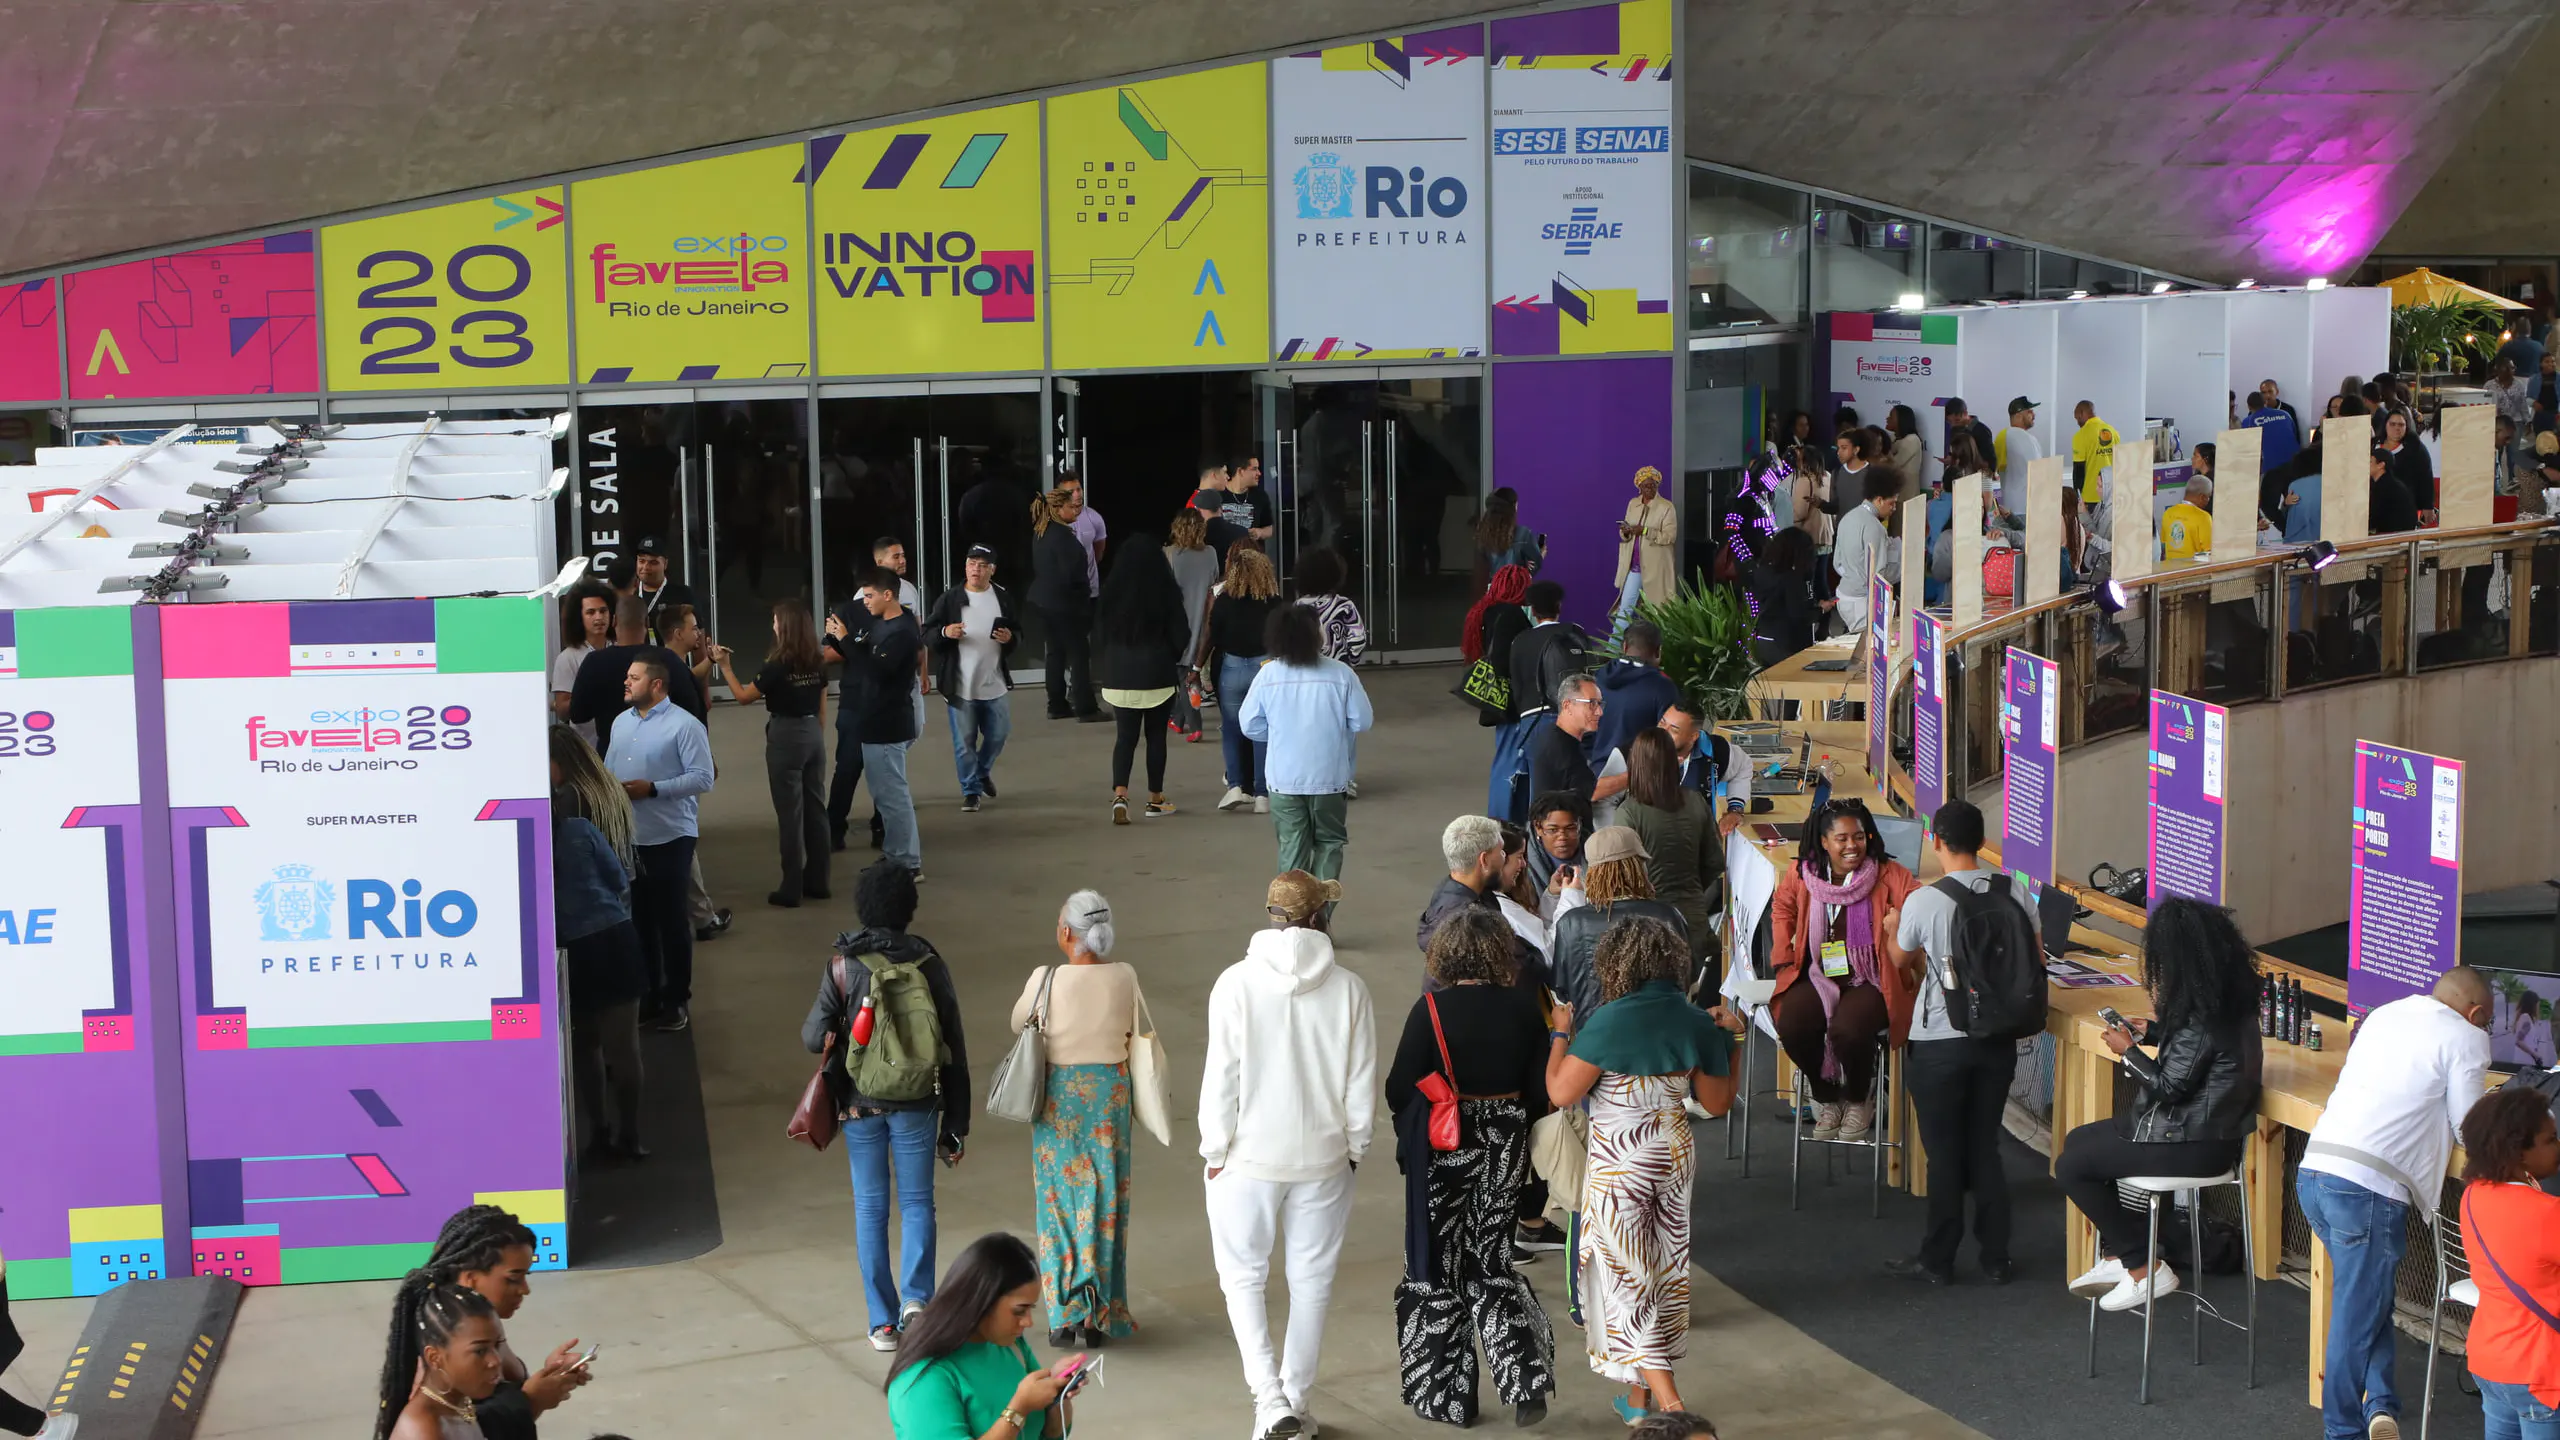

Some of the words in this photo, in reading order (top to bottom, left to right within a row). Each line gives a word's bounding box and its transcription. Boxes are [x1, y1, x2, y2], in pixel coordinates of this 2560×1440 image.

[1493, 108, 1524, 116] DIAMANTE
[1294, 136, 1320, 145] SUPER
[1321, 135, 1353, 145] MASTER
[1500, 130, 1560, 152] SESI
[1581, 129, 1663, 151] SENAI
[1524, 158, 1545, 166] PELO
[1547, 157, 1580, 166] FUTURO
[1581, 157, 1594, 165] DO
[1596, 157, 1639, 165] TRABALHO
[1366, 166, 1468, 219] Rio
[1297, 230, 1467, 247] PREFEITURA
[1541, 222, 1623, 240] SEBRAE
[673, 235, 788, 258] expo
[824, 231, 976, 264] INNO
[357, 244, 532, 309] 20
[825, 264, 1034, 298] VATION
[609, 301, 651, 317] Rio
[656, 300, 681, 316] de
[686, 300, 789, 316] Janeiro
[359, 309, 534, 375] 23
[1909, 356, 1932, 366] 20
[1909, 366, 1932, 376] 23
[186, 428, 216, 439] olução
[217, 427, 238, 436] ideal
[588, 427, 620, 514] SALA
[310, 708, 401, 727] expo
[406, 705, 472, 728] 20
[407, 728, 473, 751] 23
[301, 758, 323, 773] de
[328, 757, 419, 773] Janeiro
[2443, 776, 2455, 787] Rio
[306, 815, 348, 826] SUPER
[350, 813, 418, 825] MASTER
[2365, 809, 2386, 829] PRETA
[2364, 827, 2389, 848] PORTER
[347, 878, 478, 940] Rio
[261, 951, 479, 974] PREFEITURA
